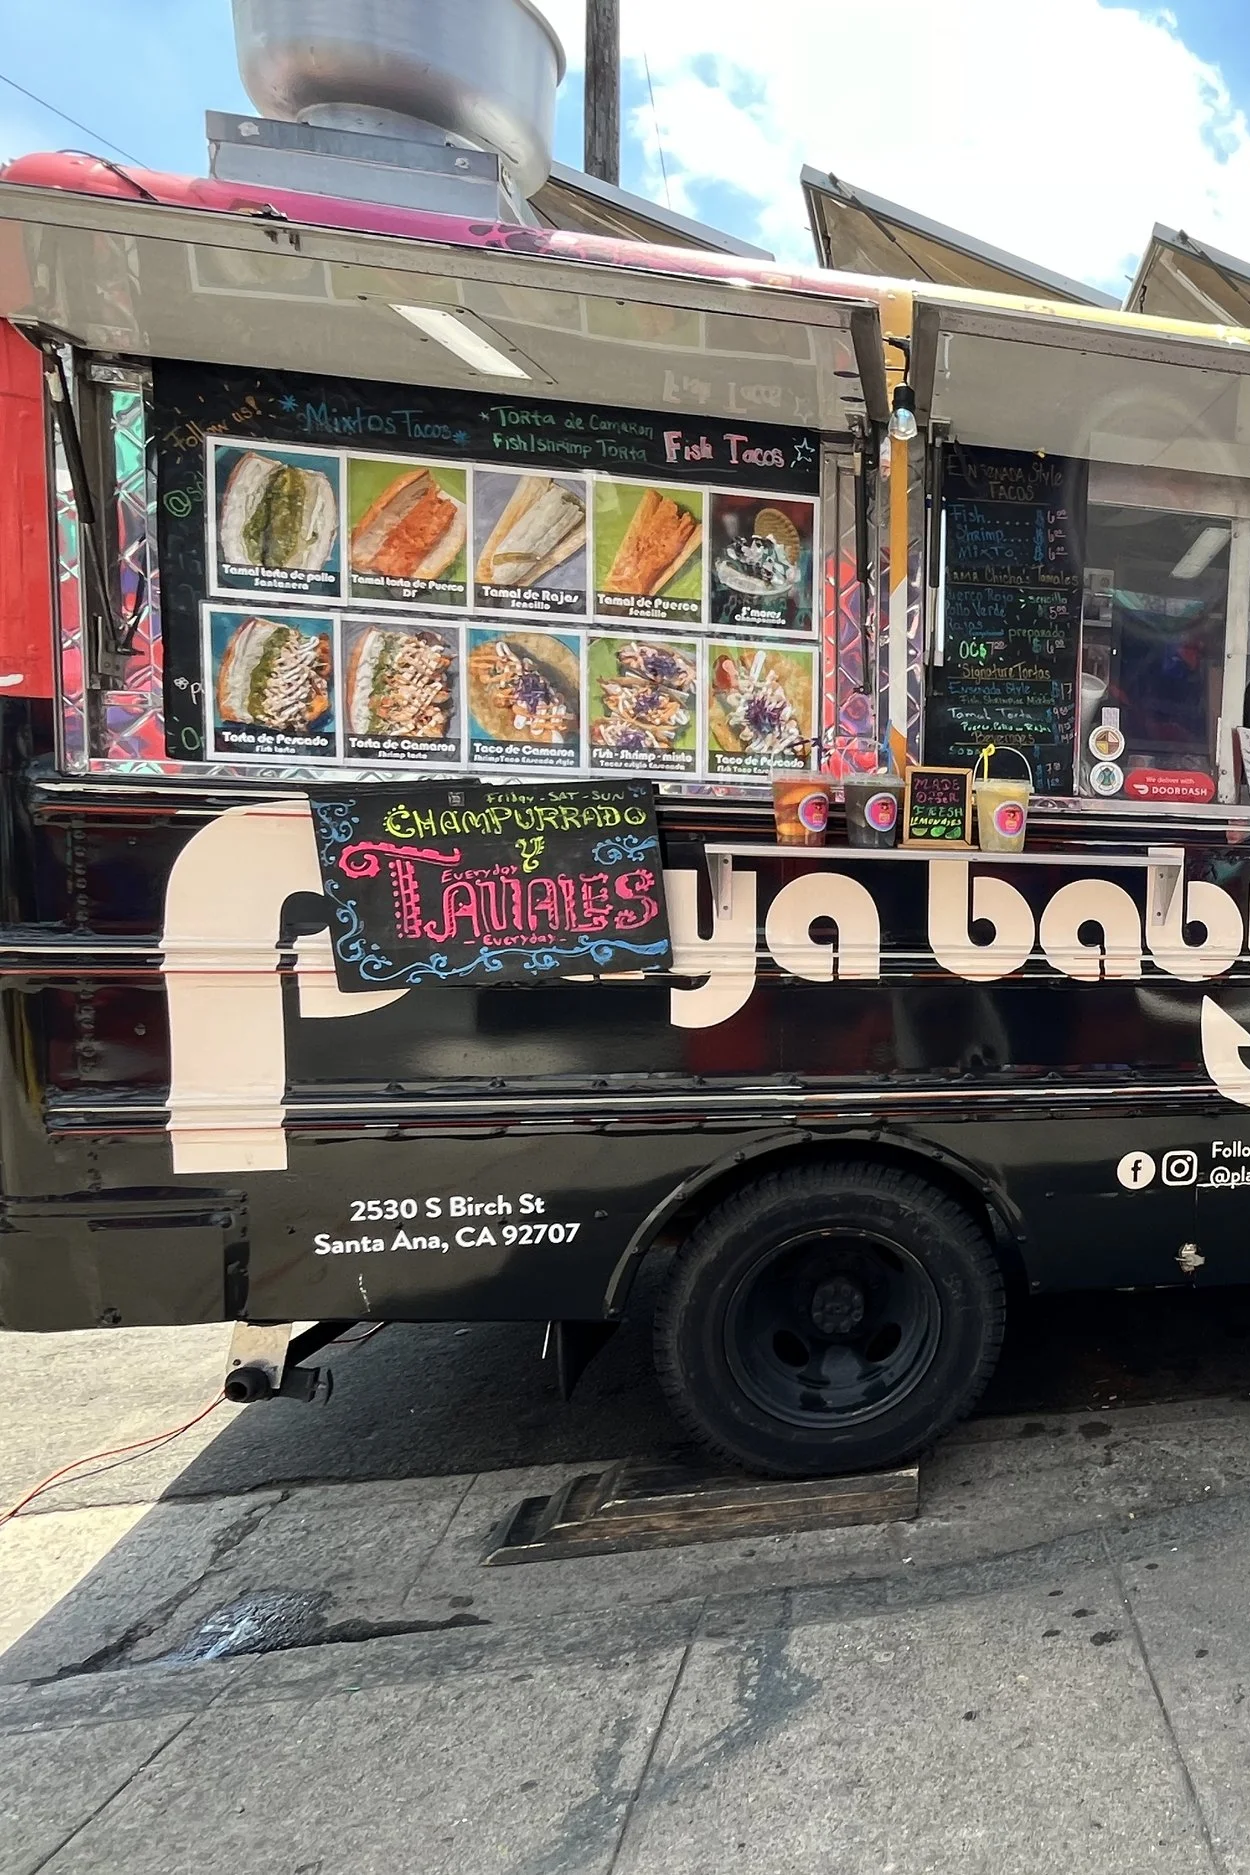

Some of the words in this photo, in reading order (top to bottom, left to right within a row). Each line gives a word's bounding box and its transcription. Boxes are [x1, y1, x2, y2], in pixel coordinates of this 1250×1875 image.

[391, 408, 451, 440] Tacos
[663, 430, 713, 463] Fish
[723, 433, 784, 468] Tacos
[221, 563, 259, 577] Tamal
[260, 567, 289, 580] torta
[290, 569, 305, 581] de
[306, 570, 336, 584] pollo
[351, 573, 385, 586] Tamal
[385, 575, 412, 588] torta
[412, 577, 427, 589] de
[427, 580, 465, 593] Puerco
[482, 584, 521, 601] Tamal
[522, 588, 540, 601] de
[541, 589, 580, 605] Rajas
[597, 592, 635, 607] Tamal
[635, 595, 652, 608] de
[653, 598, 699, 613] Puerco
[510, 599, 551, 611] Sencillo
[628, 608, 667, 619] Sencillo
[222, 731, 256, 745] Torta
[256, 733, 274, 745] de
[276, 733, 329, 747] Pescado
[349, 737, 381, 750] Torta
[382, 738, 399, 750] de
[400, 739, 456, 753] Camaron
[473, 742, 504, 755] Taco
[504, 744, 520, 755] de
[521, 745, 575, 758] Camaron
[715, 753, 746, 767] Taco
[745, 755, 760, 767] de
[914, 778, 960, 791] MADE
[1152, 786, 1208, 796] DOORDASH
[486, 792, 535, 804] Friday
[549, 791, 580, 802] SAT
[592, 791, 625, 801] SUN
[913, 805, 964, 818] FRESH
[384, 803, 647, 839] CHAMPURRADO
[482, 933, 556, 947] Everyday
[350, 1198, 418, 1222] 2530
[425, 1197, 442, 1219] S
[449, 1194, 513, 1218] Birch
[519, 1193, 545, 1216] St
[313, 1232, 385, 1255] Santa
[391, 1229, 450, 1253] Ana,
[454, 1226, 497, 1248] CA
[502, 1222, 581, 1247] 92707
